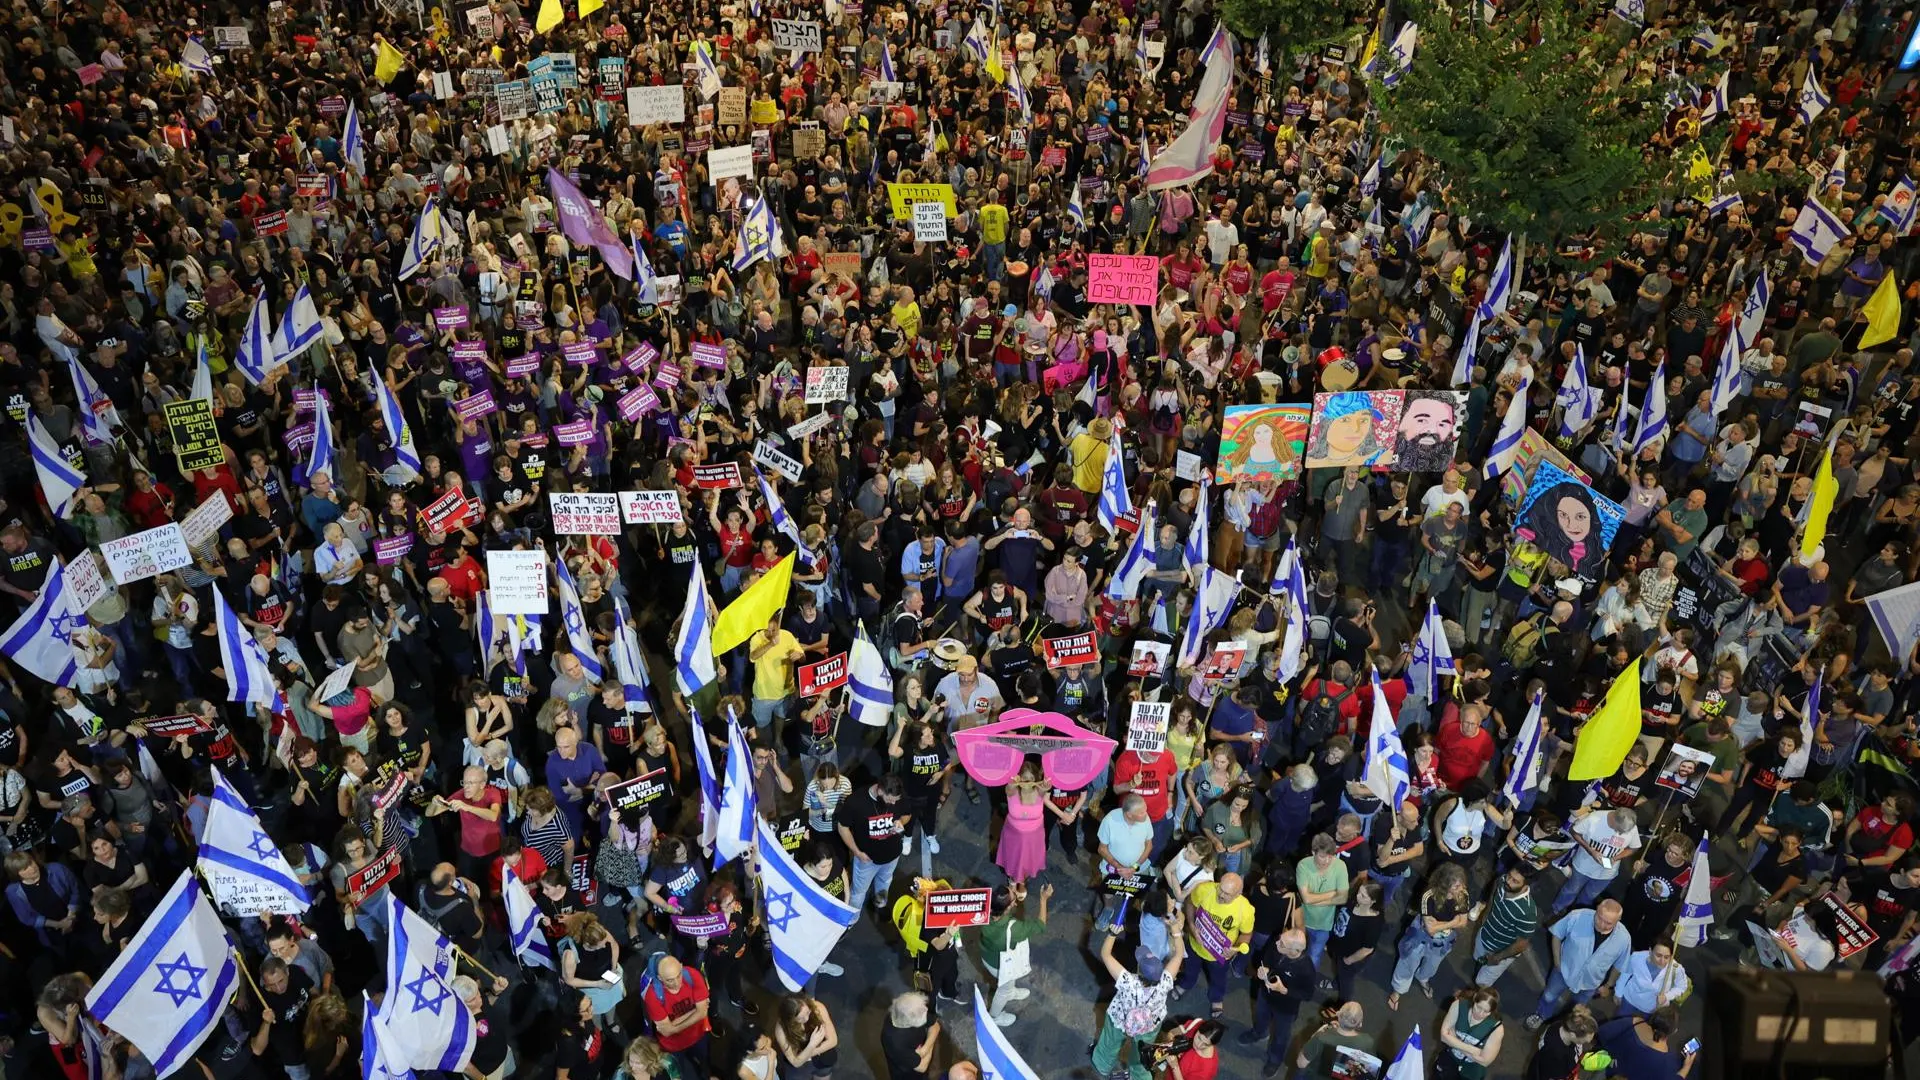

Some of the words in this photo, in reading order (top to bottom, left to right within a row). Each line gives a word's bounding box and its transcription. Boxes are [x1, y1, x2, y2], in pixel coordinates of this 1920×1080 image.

[773, 20, 817, 36] תצילו
[778, 35, 817, 47] אותנו
[602, 64, 622, 73] SEAL
[604, 73, 620, 82] THE
[533, 78, 556, 91] SEAL
[538, 88, 556, 99] THE
[897, 188, 941, 197] החזירו
[1093, 272, 1112, 282] את
[1092, 284, 1152, 302] החטופים
[9, 394, 24, 405] לא
[197, 402, 208, 411] יום
[172, 412, 211, 426] החטופים
[206, 438, 217, 447] יום
[62, 444, 75, 457] לא
[528, 454, 539, 463] לא
[584, 496, 616, 505] סינוואר
[575, 506, 590, 514] היה
[594, 504, 616, 514] לביבי
[666, 502, 676, 511] יש
[112, 548, 142, 561] מתים
[125, 554, 152, 567] ביבי
[1053, 639, 1072, 650] קלון
[1074, 636, 1090, 646] אות
[1058, 648, 1071, 658] קין
[1072, 646, 1091, 655] ואות
[816, 658, 841, 676] לדראון
[816, 668, 844, 686] עולם!
[1138, 704, 1151, 714] עת
[1152, 704, 1165, 716] לא
[1130, 728, 1143, 740] של
[1144, 731, 1166, 742] תורה
[1133, 740, 1159, 750] עסקה
[789, 818, 801, 830] לא
[868, 816, 894, 830] FCK
[386, 850, 396, 865] את
[930, 895, 959, 904] ISRAELIS
[961, 894, 987, 903] CHOOSE
[947, 902, 983, 913] HOSTAGES!
[1824, 897, 1838, 911] OUR
[1836, 908, 1860, 932] SISTERS
[1856, 927, 1872, 942] ARE
[1836, 924, 1849, 937] FOR
[1846, 934, 1863, 948] HELP
